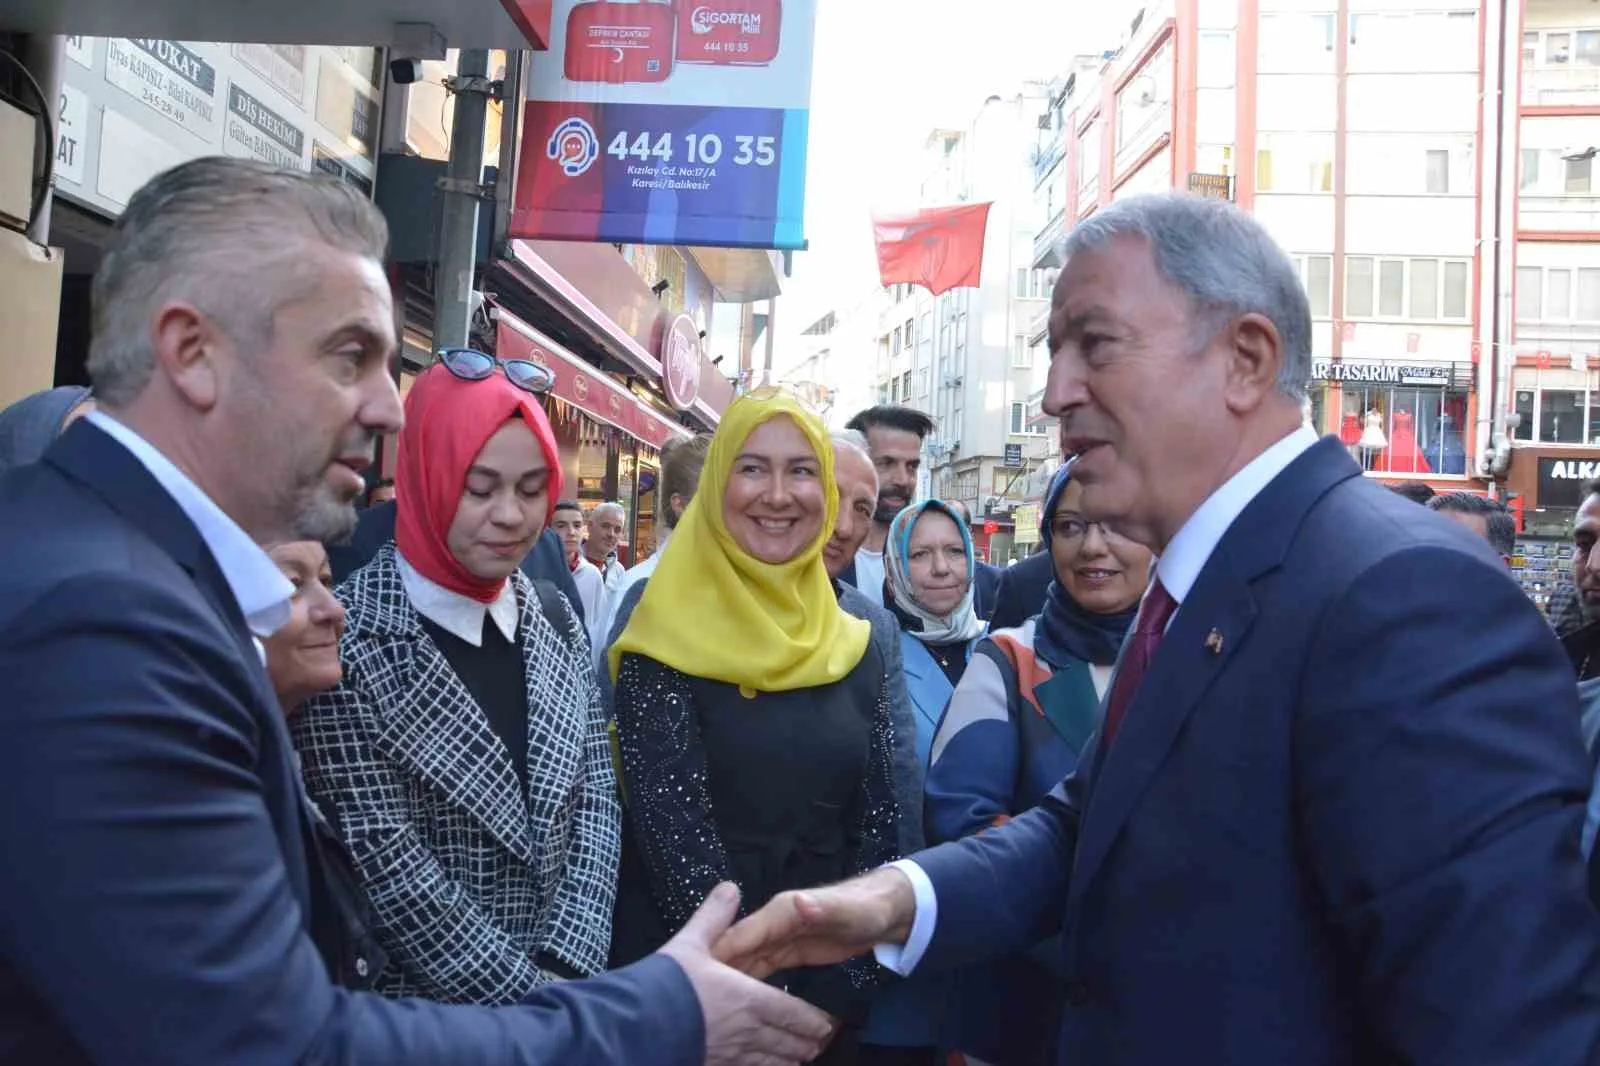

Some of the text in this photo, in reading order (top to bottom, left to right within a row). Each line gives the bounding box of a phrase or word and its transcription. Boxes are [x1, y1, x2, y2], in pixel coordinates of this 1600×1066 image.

[138, 38, 201, 82] VUKAT
[57, 134, 77, 167] AT
[607, 131, 776, 167] 444 10 35
[627, 165, 660, 177] Kızılay
[661, 166, 677, 176] Cd.
[1311, 362, 1329, 380] AR
[1333, 364, 1400, 383] TASARIM
